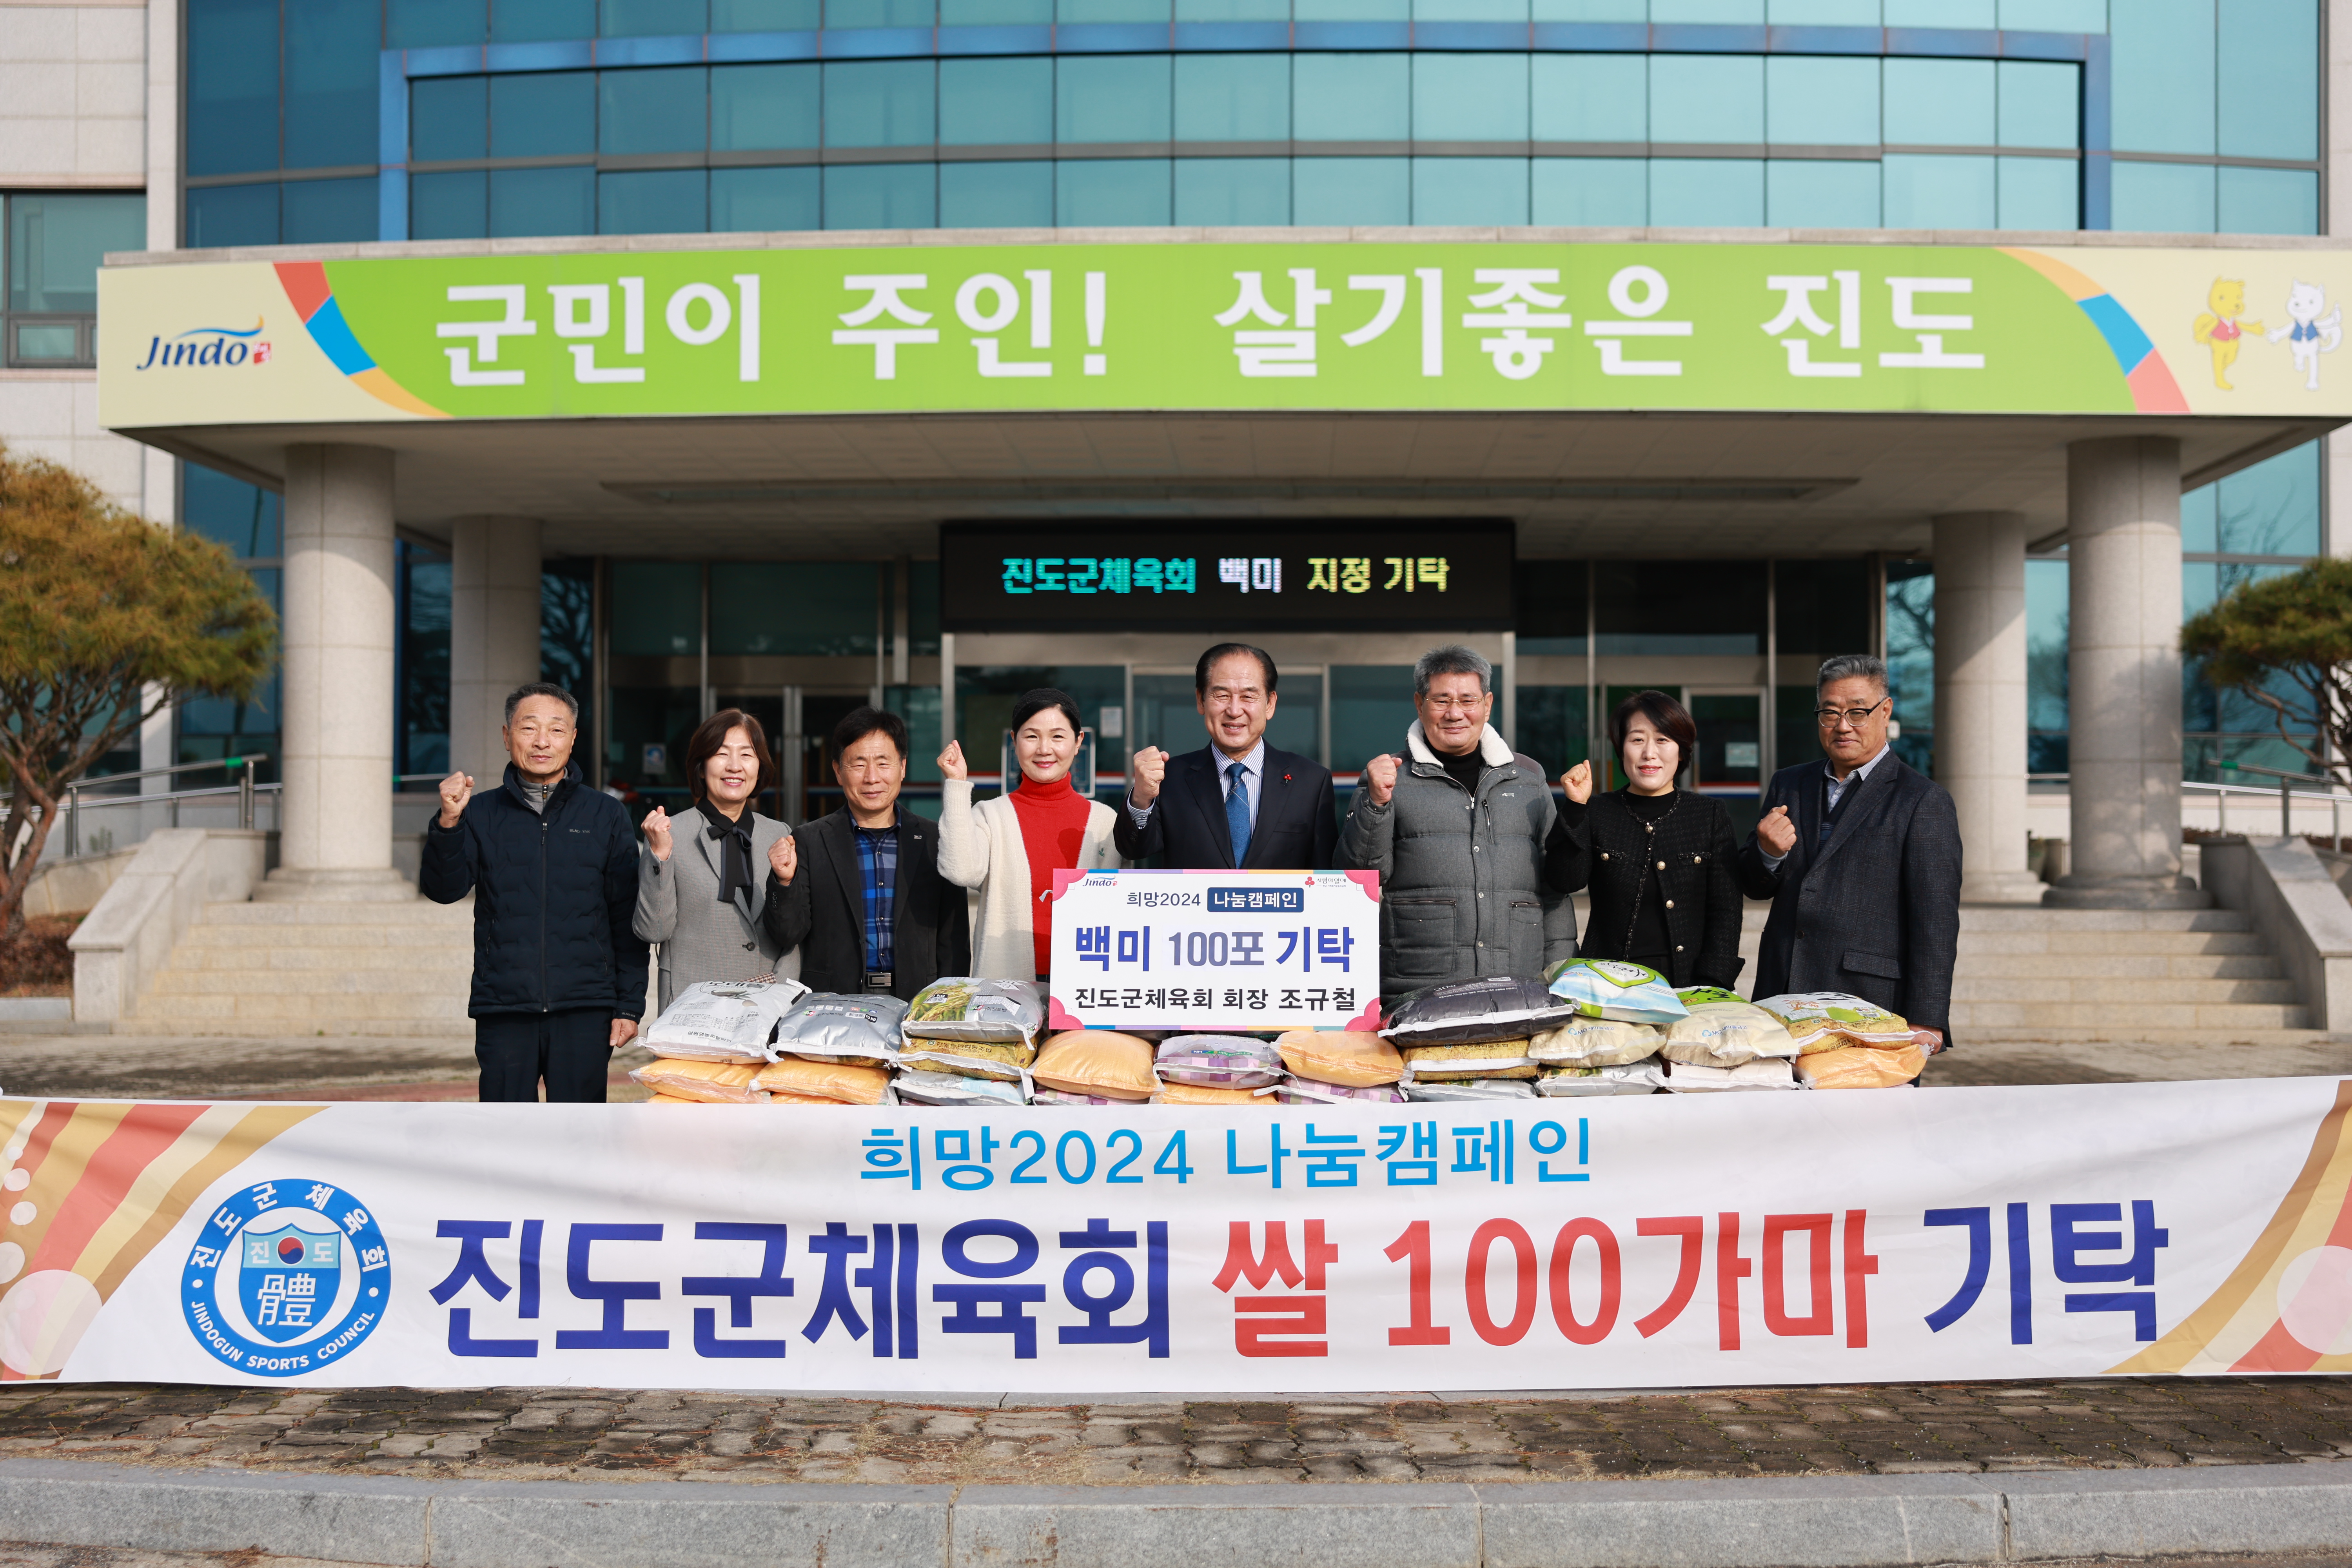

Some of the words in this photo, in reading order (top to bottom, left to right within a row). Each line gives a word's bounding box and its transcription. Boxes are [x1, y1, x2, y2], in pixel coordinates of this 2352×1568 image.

[436, 273, 760, 387] 군민이
[831, 269, 1107, 380] 주인!
[1213, 264, 1694, 381] 살기좋은
[1759, 269, 1986, 378] 진도
[136, 334, 249, 371] Jindo
[1001, 557, 1196, 594] 진도군체육회
[1218, 557, 1282, 593] 백미
[1306, 557, 1371, 594] 지정
[1383, 557, 1450, 593] 기탁
[1082, 878, 1112, 887] Jindo
[1126, 891, 1201, 907] 희망2024
[1214, 891, 1298, 908] 나눔캠페인
[1075, 925, 1151, 972] 백미
[1168, 931, 1265, 967] 100포
[1275, 926, 1355, 973] 기탁
[1074, 987, 1212, 1010] 진도군체육회
[1222, 988, 1269, 1010] 회장
[1278, 987, 1355, 1011] 조규철
[860, 1125, 1194, 1191] 희망2024
[1226, 1117, 1590, 1189] 나눔캠페인
[191, 1182, 388, 1272] 진도군체육회
[257, 1273, 316, 1327] 體
[428, 1218, 1170, 1359] 진도군체육회
[1212, 1219, 1339, 1358] 쌀
[1383, 1209, 1879, 1351] 100가마
[1924, 1200, 2172, 1344] 기탁
[191, 1301, 243, 1361] JINDOGUN
[247, 1355, 309, 1370] SPORTS
[317, 1311, 375, 1359] COUNCIL
